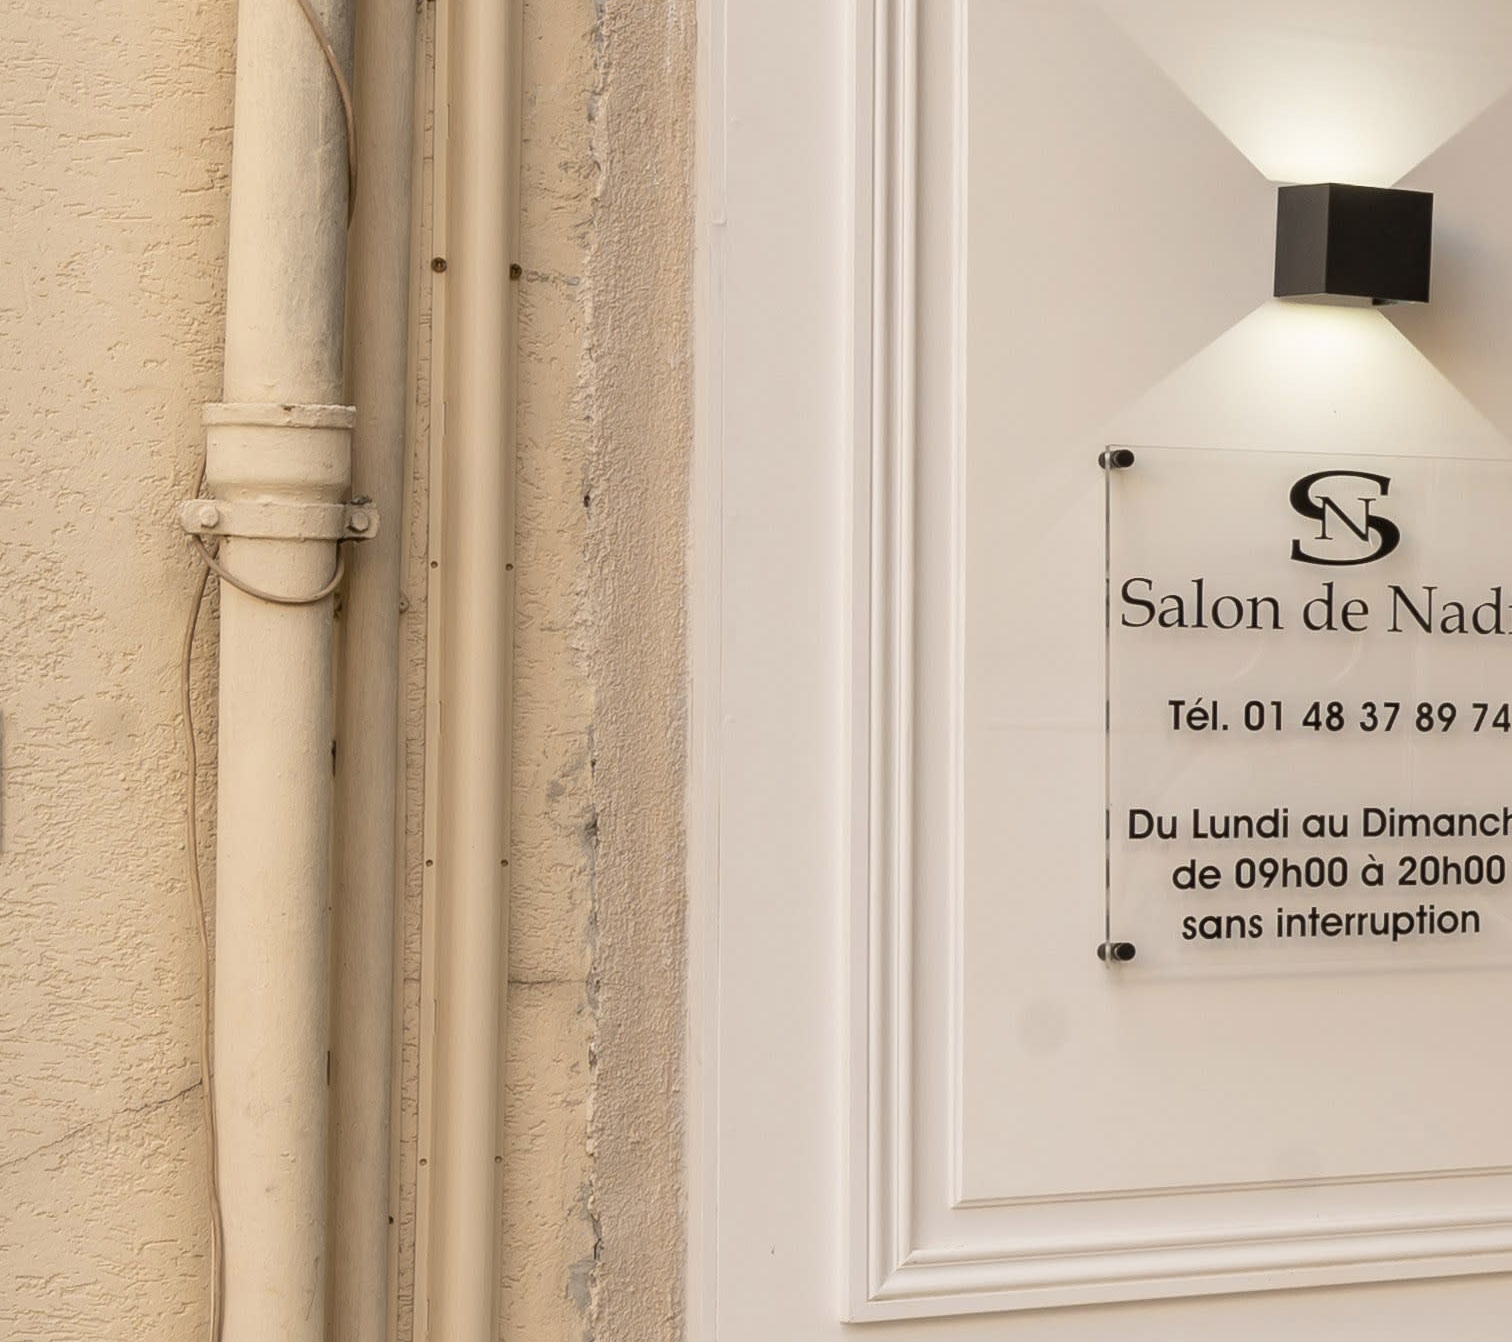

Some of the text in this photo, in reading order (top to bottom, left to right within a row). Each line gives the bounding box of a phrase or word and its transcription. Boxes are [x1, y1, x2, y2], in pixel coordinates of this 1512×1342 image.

[1121, 577, 1284, 630] Salon
[1303, 581, 1369, 632] de
[1168, 697, 1511, 733] Tél. 01 48 37 89 74
[1128, 808, 1177, 840] Du
[1193, 808, 1289, 839] Lundi
[1302, 814, 1348, 838] au
[1172, 853, 1506, 890] de 09h00 à 20h00
[1182, 904, 1480, 942] sans interruption
